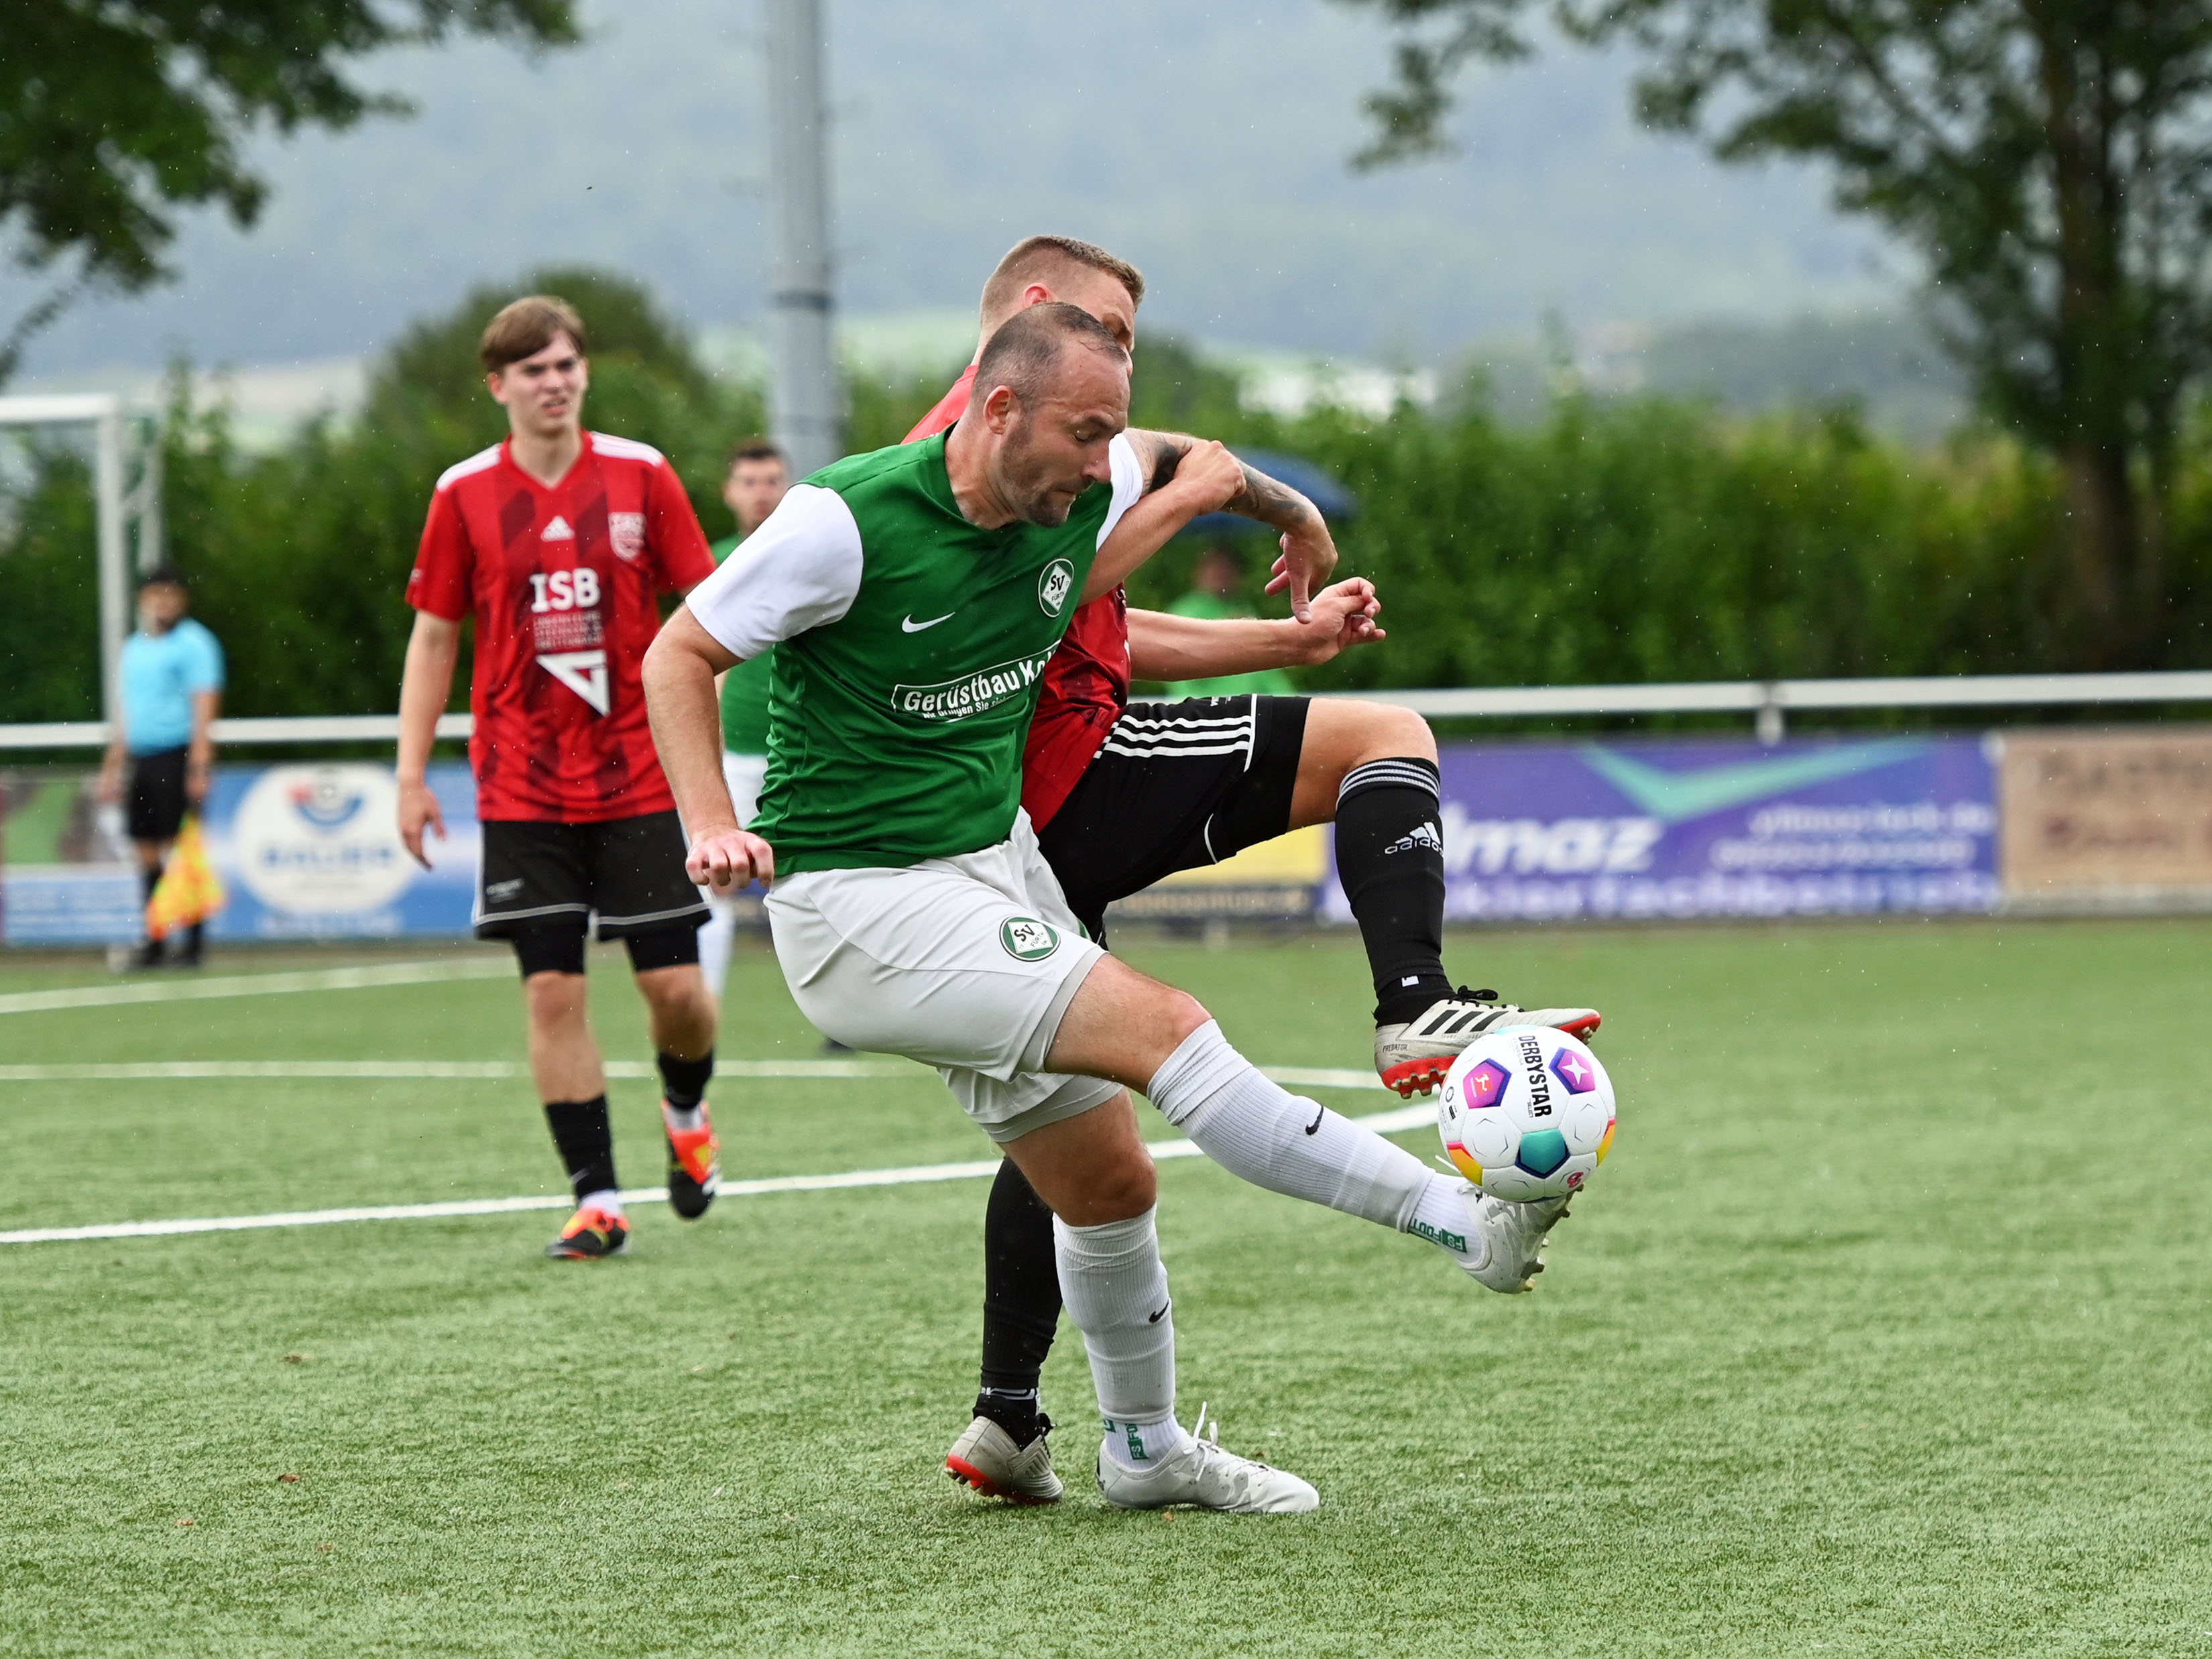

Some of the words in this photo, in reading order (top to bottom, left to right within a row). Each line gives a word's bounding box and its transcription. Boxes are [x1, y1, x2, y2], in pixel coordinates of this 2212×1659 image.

[529, 567, 601, 613] ISB
[1050, 574, 1065, 591] SV
[903, 670, 1021, 712] Gerüstbau
[975, 701, 990, 712] Sie
[1442, 803, 1663, 872] lmaz
[1013, 923, 1035, 943] SV
[1517, 1035, 1552, 1118] DERBYSTAR
